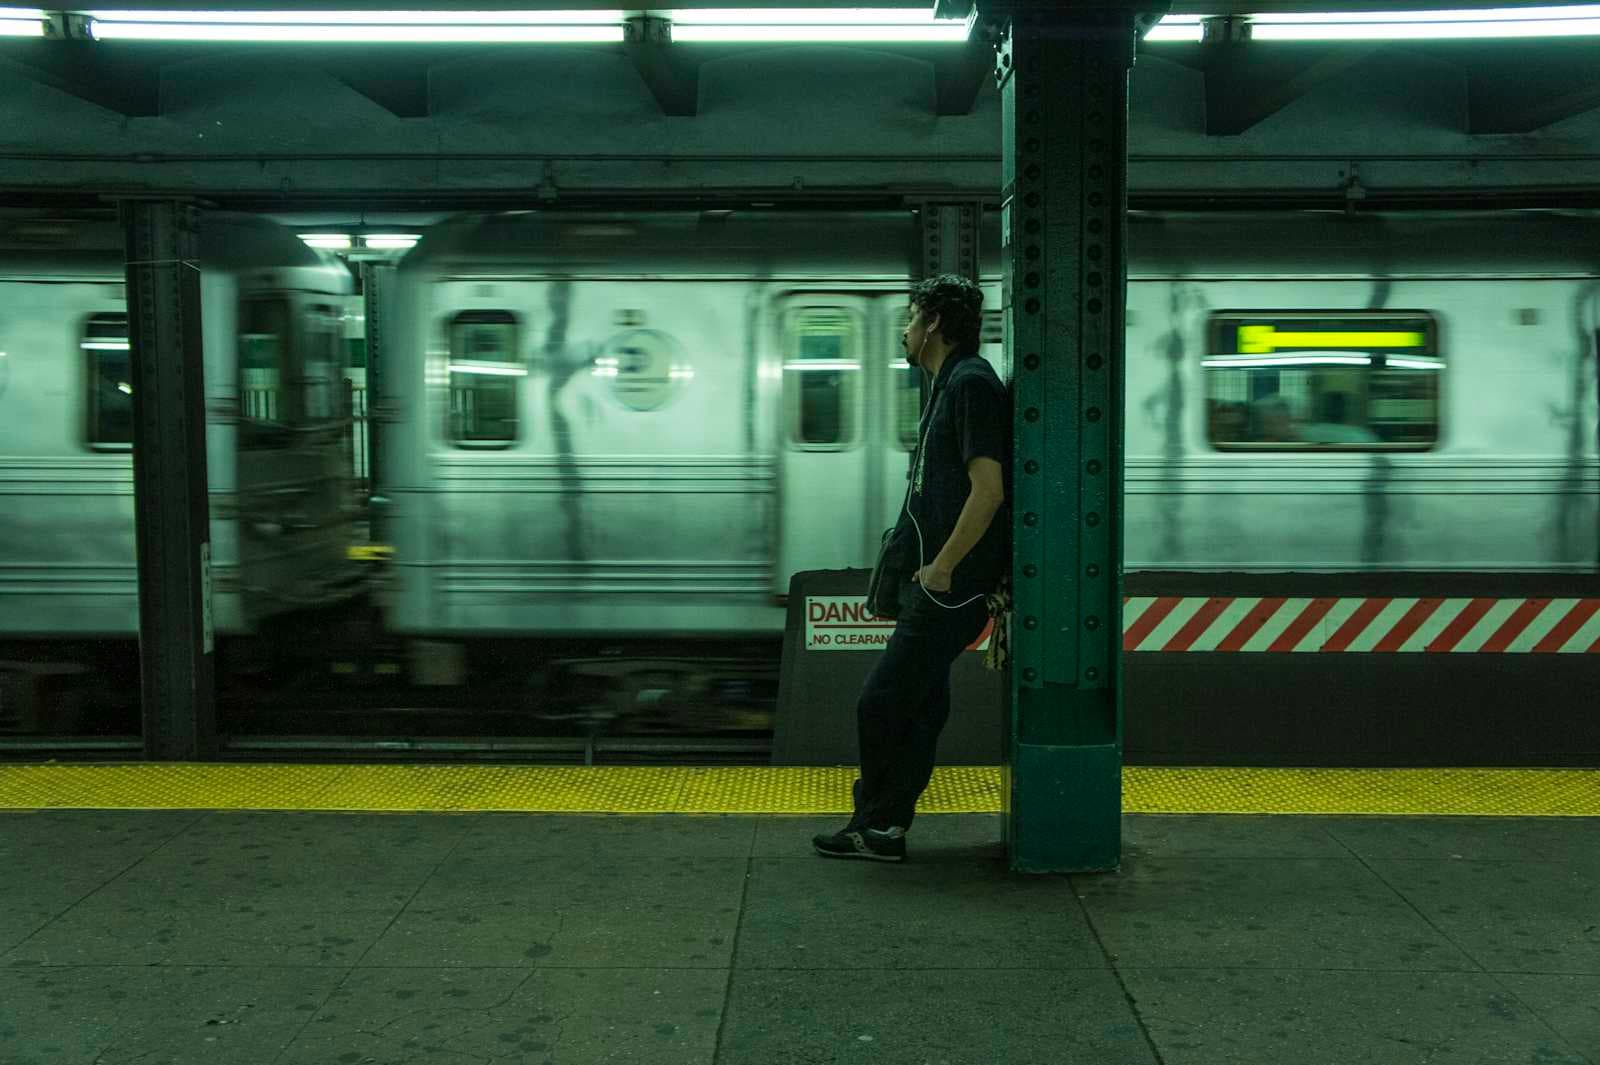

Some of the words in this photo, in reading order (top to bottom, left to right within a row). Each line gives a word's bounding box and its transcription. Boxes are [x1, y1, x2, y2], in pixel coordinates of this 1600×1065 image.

[809, 603, 896, 622] DANG
[813, 634, 831, 645] NO
[834, 634, 890, 645] CLEARAN
